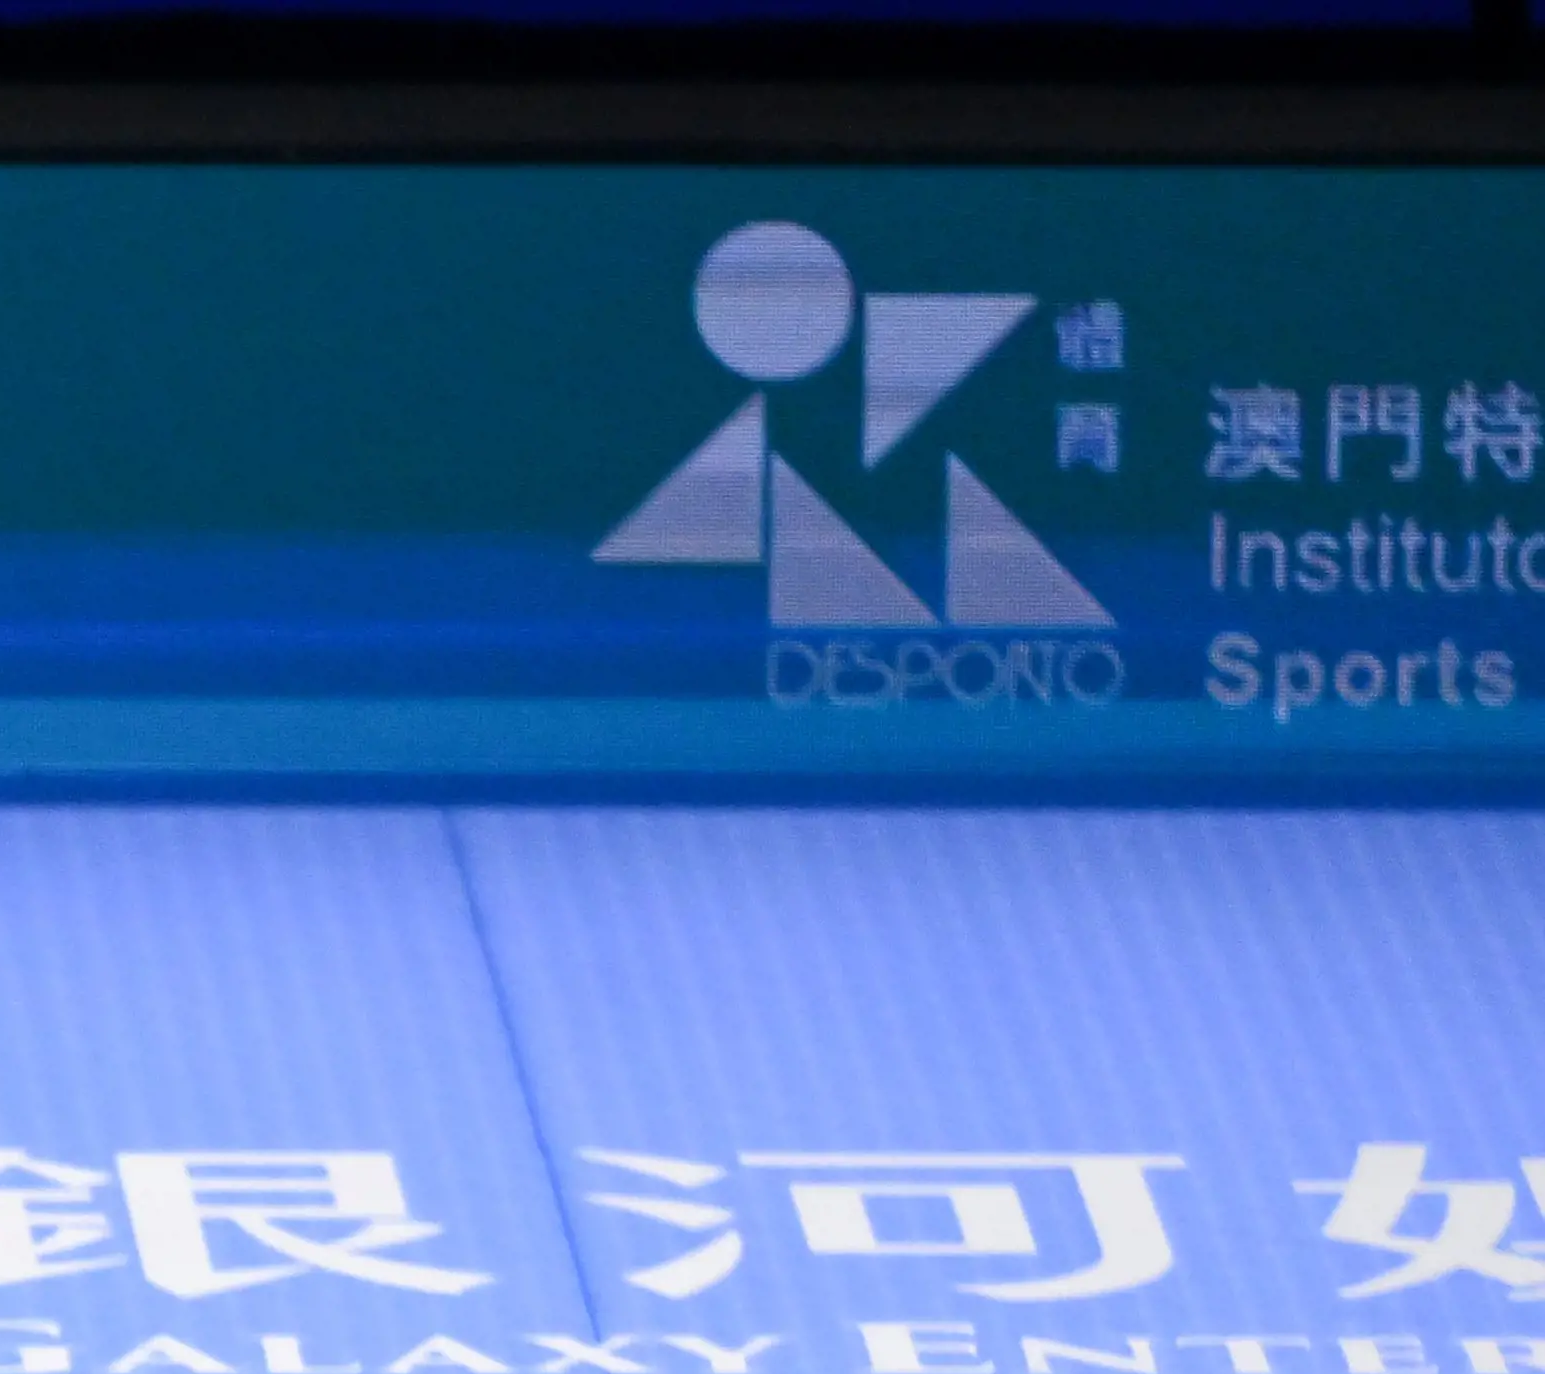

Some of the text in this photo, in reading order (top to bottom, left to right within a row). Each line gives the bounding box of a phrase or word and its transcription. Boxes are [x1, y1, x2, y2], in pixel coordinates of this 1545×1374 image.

[1205, 380, 1544, 483] 澳門特
[1205, 632, 1518, 725] Sports
